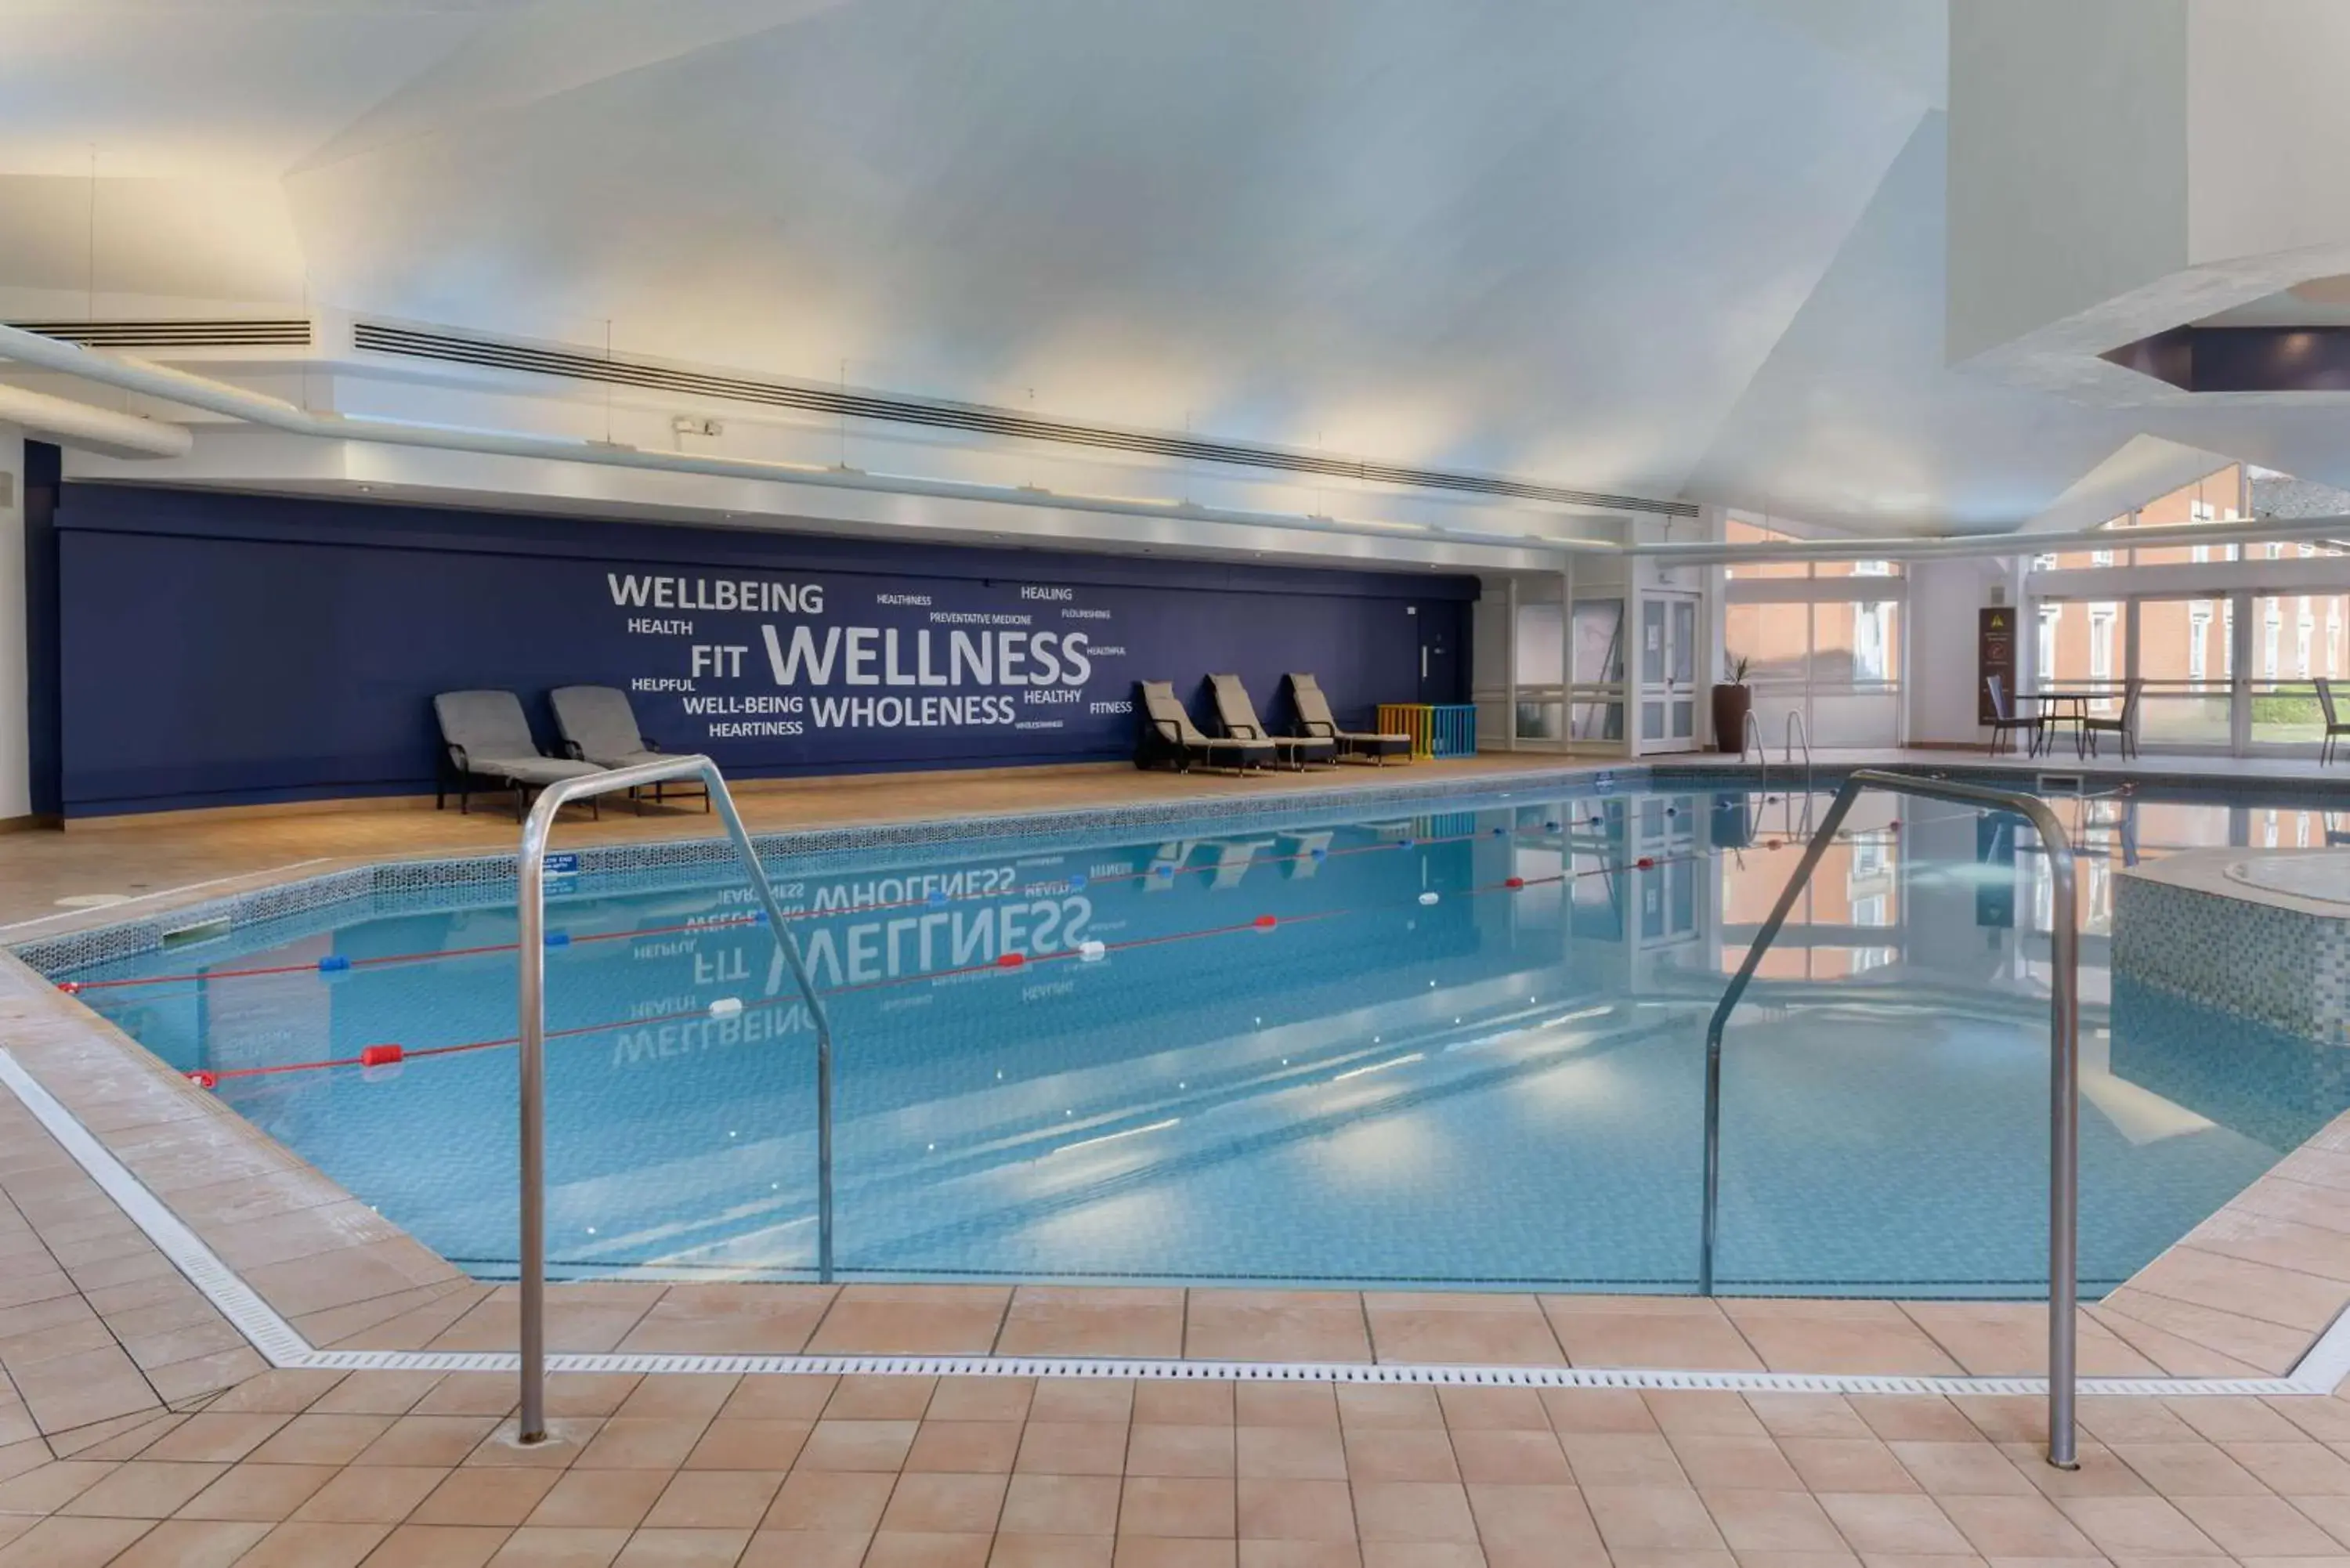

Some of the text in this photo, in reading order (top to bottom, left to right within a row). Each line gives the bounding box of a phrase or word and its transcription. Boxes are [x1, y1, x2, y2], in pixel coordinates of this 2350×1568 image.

[608, 573, 823, 614] WELLBEING
[1021, 587, 1072, 600] HEALING
[930, 612, 990, 624] PREVENTATIVE
[628, 618, 692, 635] HEALTH
[692, 645, 748, 677] FIT
[761, 624, 1091, 686] WELLNESS
[631, 678, 696, 692] HELPFUL
[1024, 689, 1082, 704] HEALTHY
[682, 696, 803, 714] WELL-BEING
[810, 695, 1016, 728] WHOLENESS
[1090, 701, 1133, 714] FITNESS
[709, 721, 803, 737] HEARTINESS
